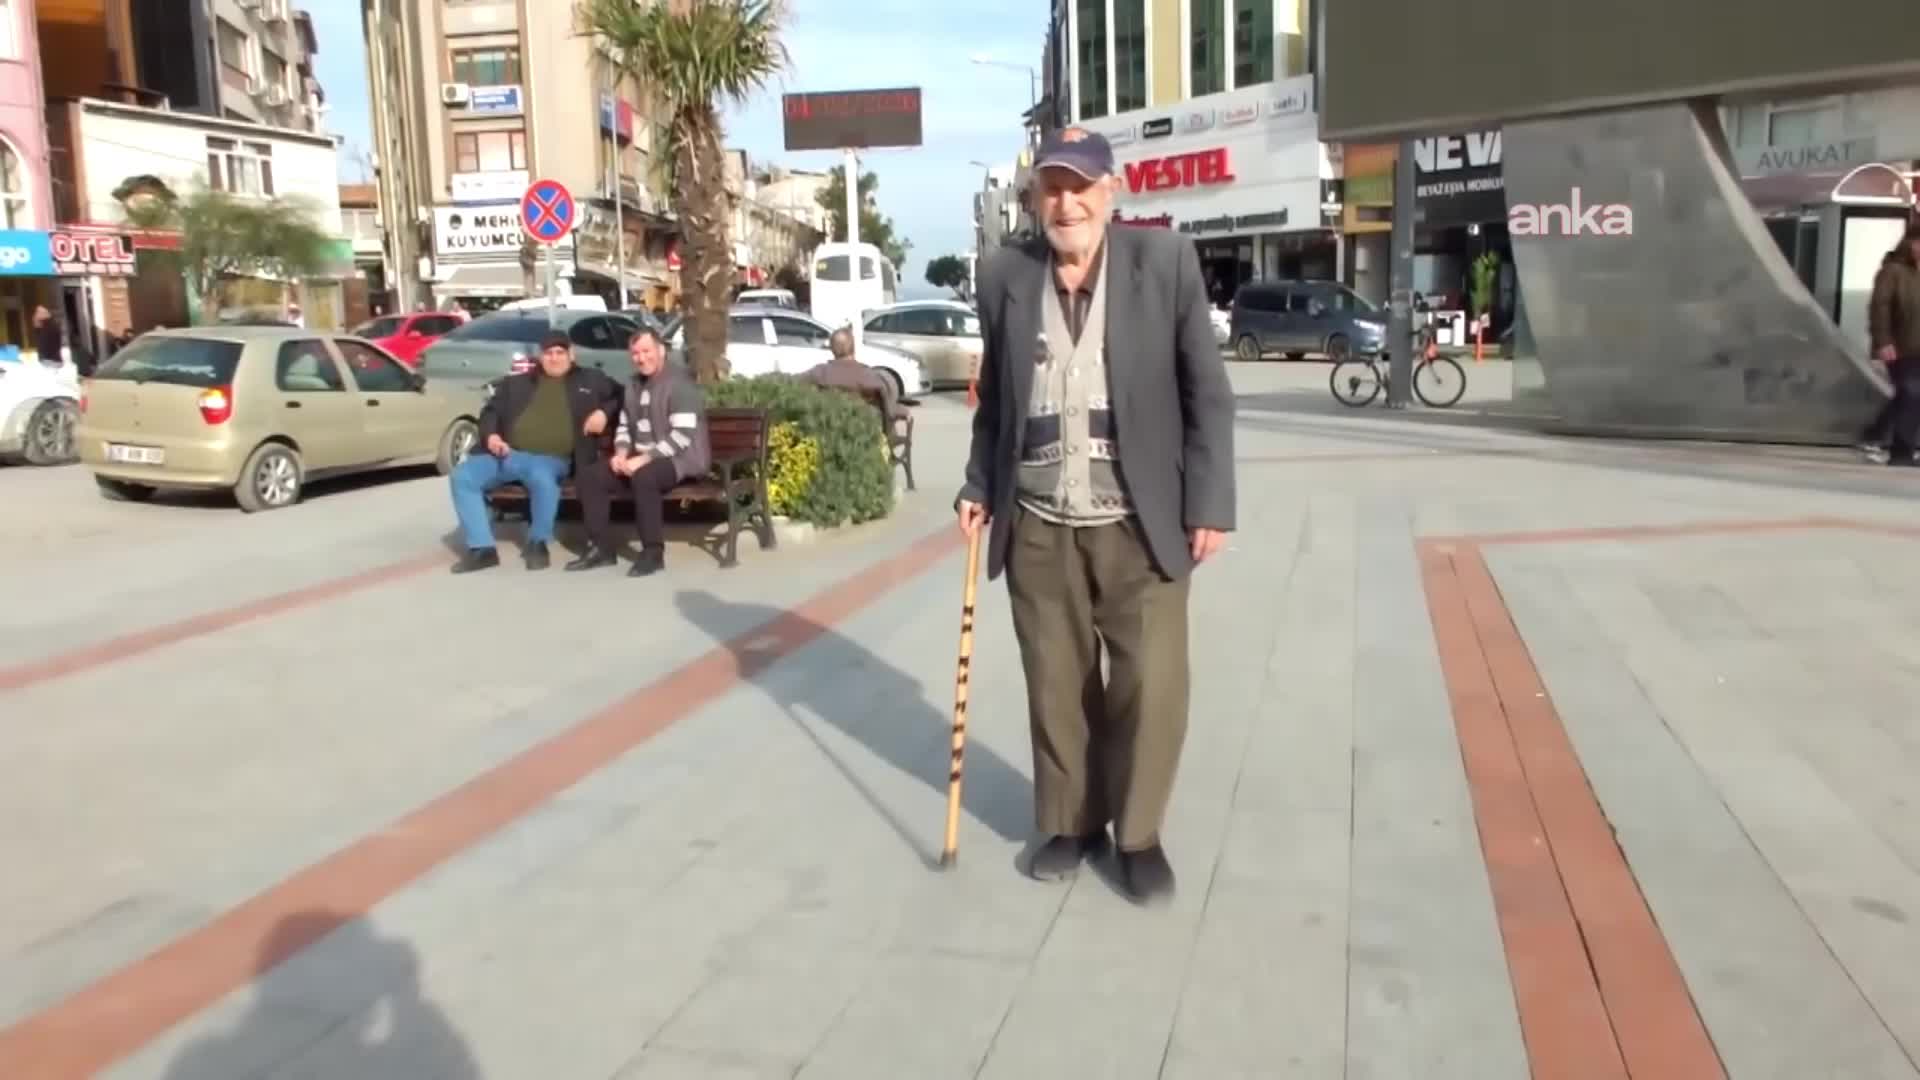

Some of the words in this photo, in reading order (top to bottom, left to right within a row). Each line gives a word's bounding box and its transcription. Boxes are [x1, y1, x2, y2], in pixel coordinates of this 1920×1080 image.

[1758, 142, 1857, 170] AVUKAT
[1124, 147, 1236, 195] VESTEL
[52, 233, 134, 262] OTEL
